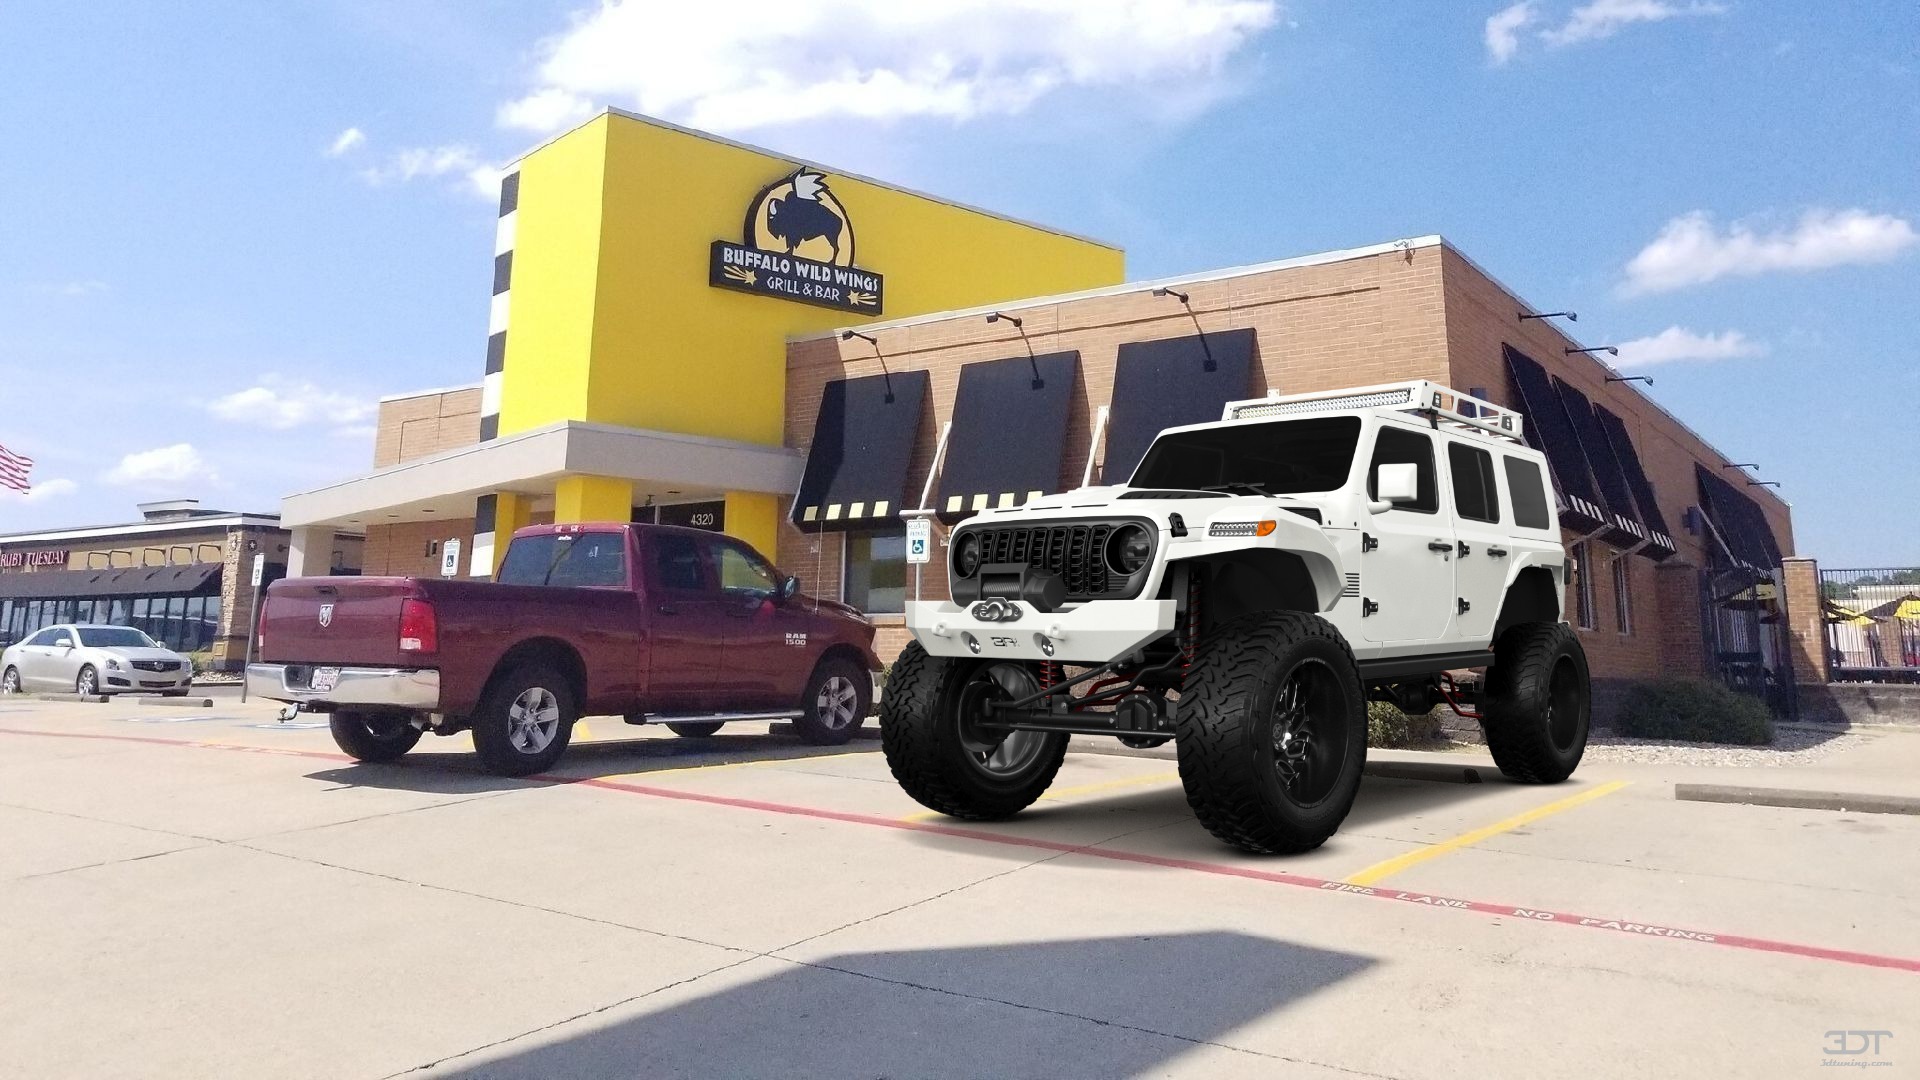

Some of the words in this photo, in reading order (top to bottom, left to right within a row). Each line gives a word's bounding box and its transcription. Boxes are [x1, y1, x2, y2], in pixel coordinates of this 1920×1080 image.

[723, 247, 791, 274] BUFFALO
[795, 261, 831, 282] WILD
[834, 269, 878, 292] WINGS
[766, 276, 800, 295] GRILL
[802, 284, 812, 297] &
[815, 285, 840, 302] BAR
[690, 513, 714, 526] 4320
[0, 553, 22, 567] RUBY
[26, 550, 65, 566] TUESDAY
[1320, 881, 1376, 895] FIRE
[1394, 892, 1472, 909] LANE
[1513, 908, 1555, 921] NO
[1579, 917, 1716, 943] PARKING
